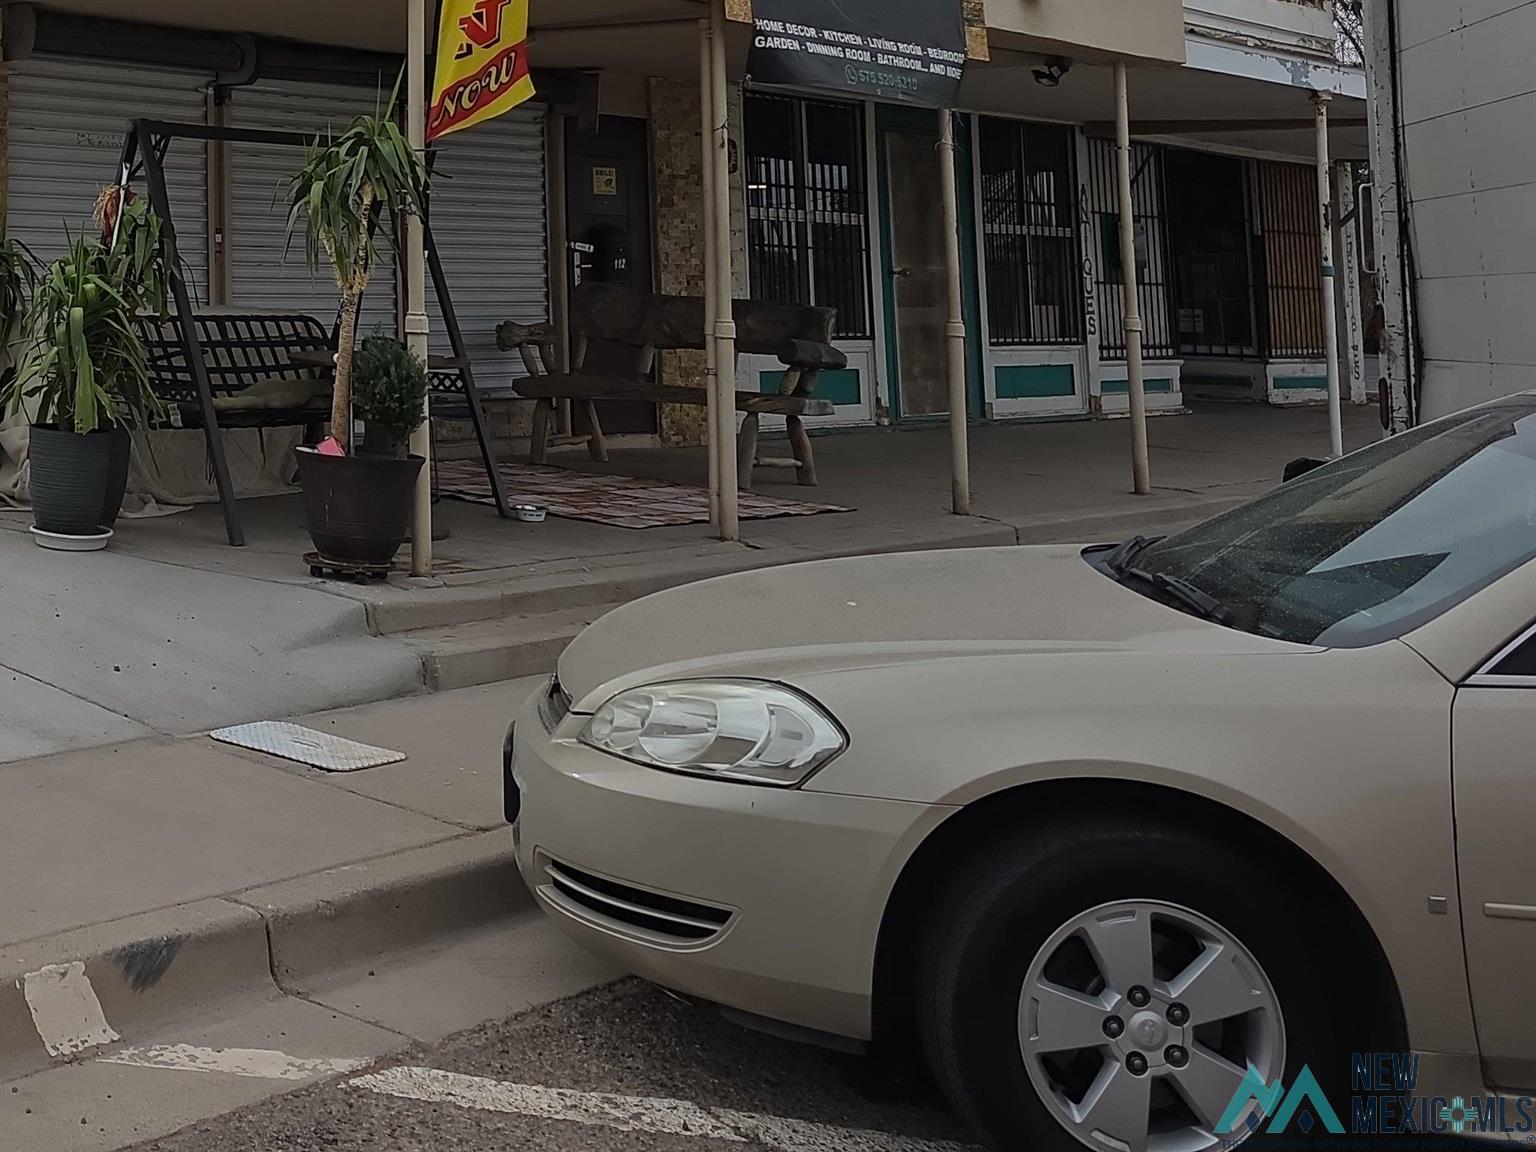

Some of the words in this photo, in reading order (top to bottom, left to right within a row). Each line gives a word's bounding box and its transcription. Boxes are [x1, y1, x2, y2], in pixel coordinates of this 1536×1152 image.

[754, 35, 801, 51] GARDEN
[805, 41, 844, 58] DINNING
[845, 48, 871, 62] ROOM
[929, 63, 946, 75] AND
[755, 18, 785, 33] HOME
[785, 23, 818, 38] DECOR
[823, 29, 863, 46] KITCHEN
[867, 37, 897, 51] LIVING
[897, 42, 923, 56] ROOM
[927, 48, 964, 64] BEDROOM
[431, 51, 516, 128] NOW
[858, 69, 876, 83] 575
[878, 72, 894, 87] 520
[1080, 183, 1097, 336] ANTIQUES
